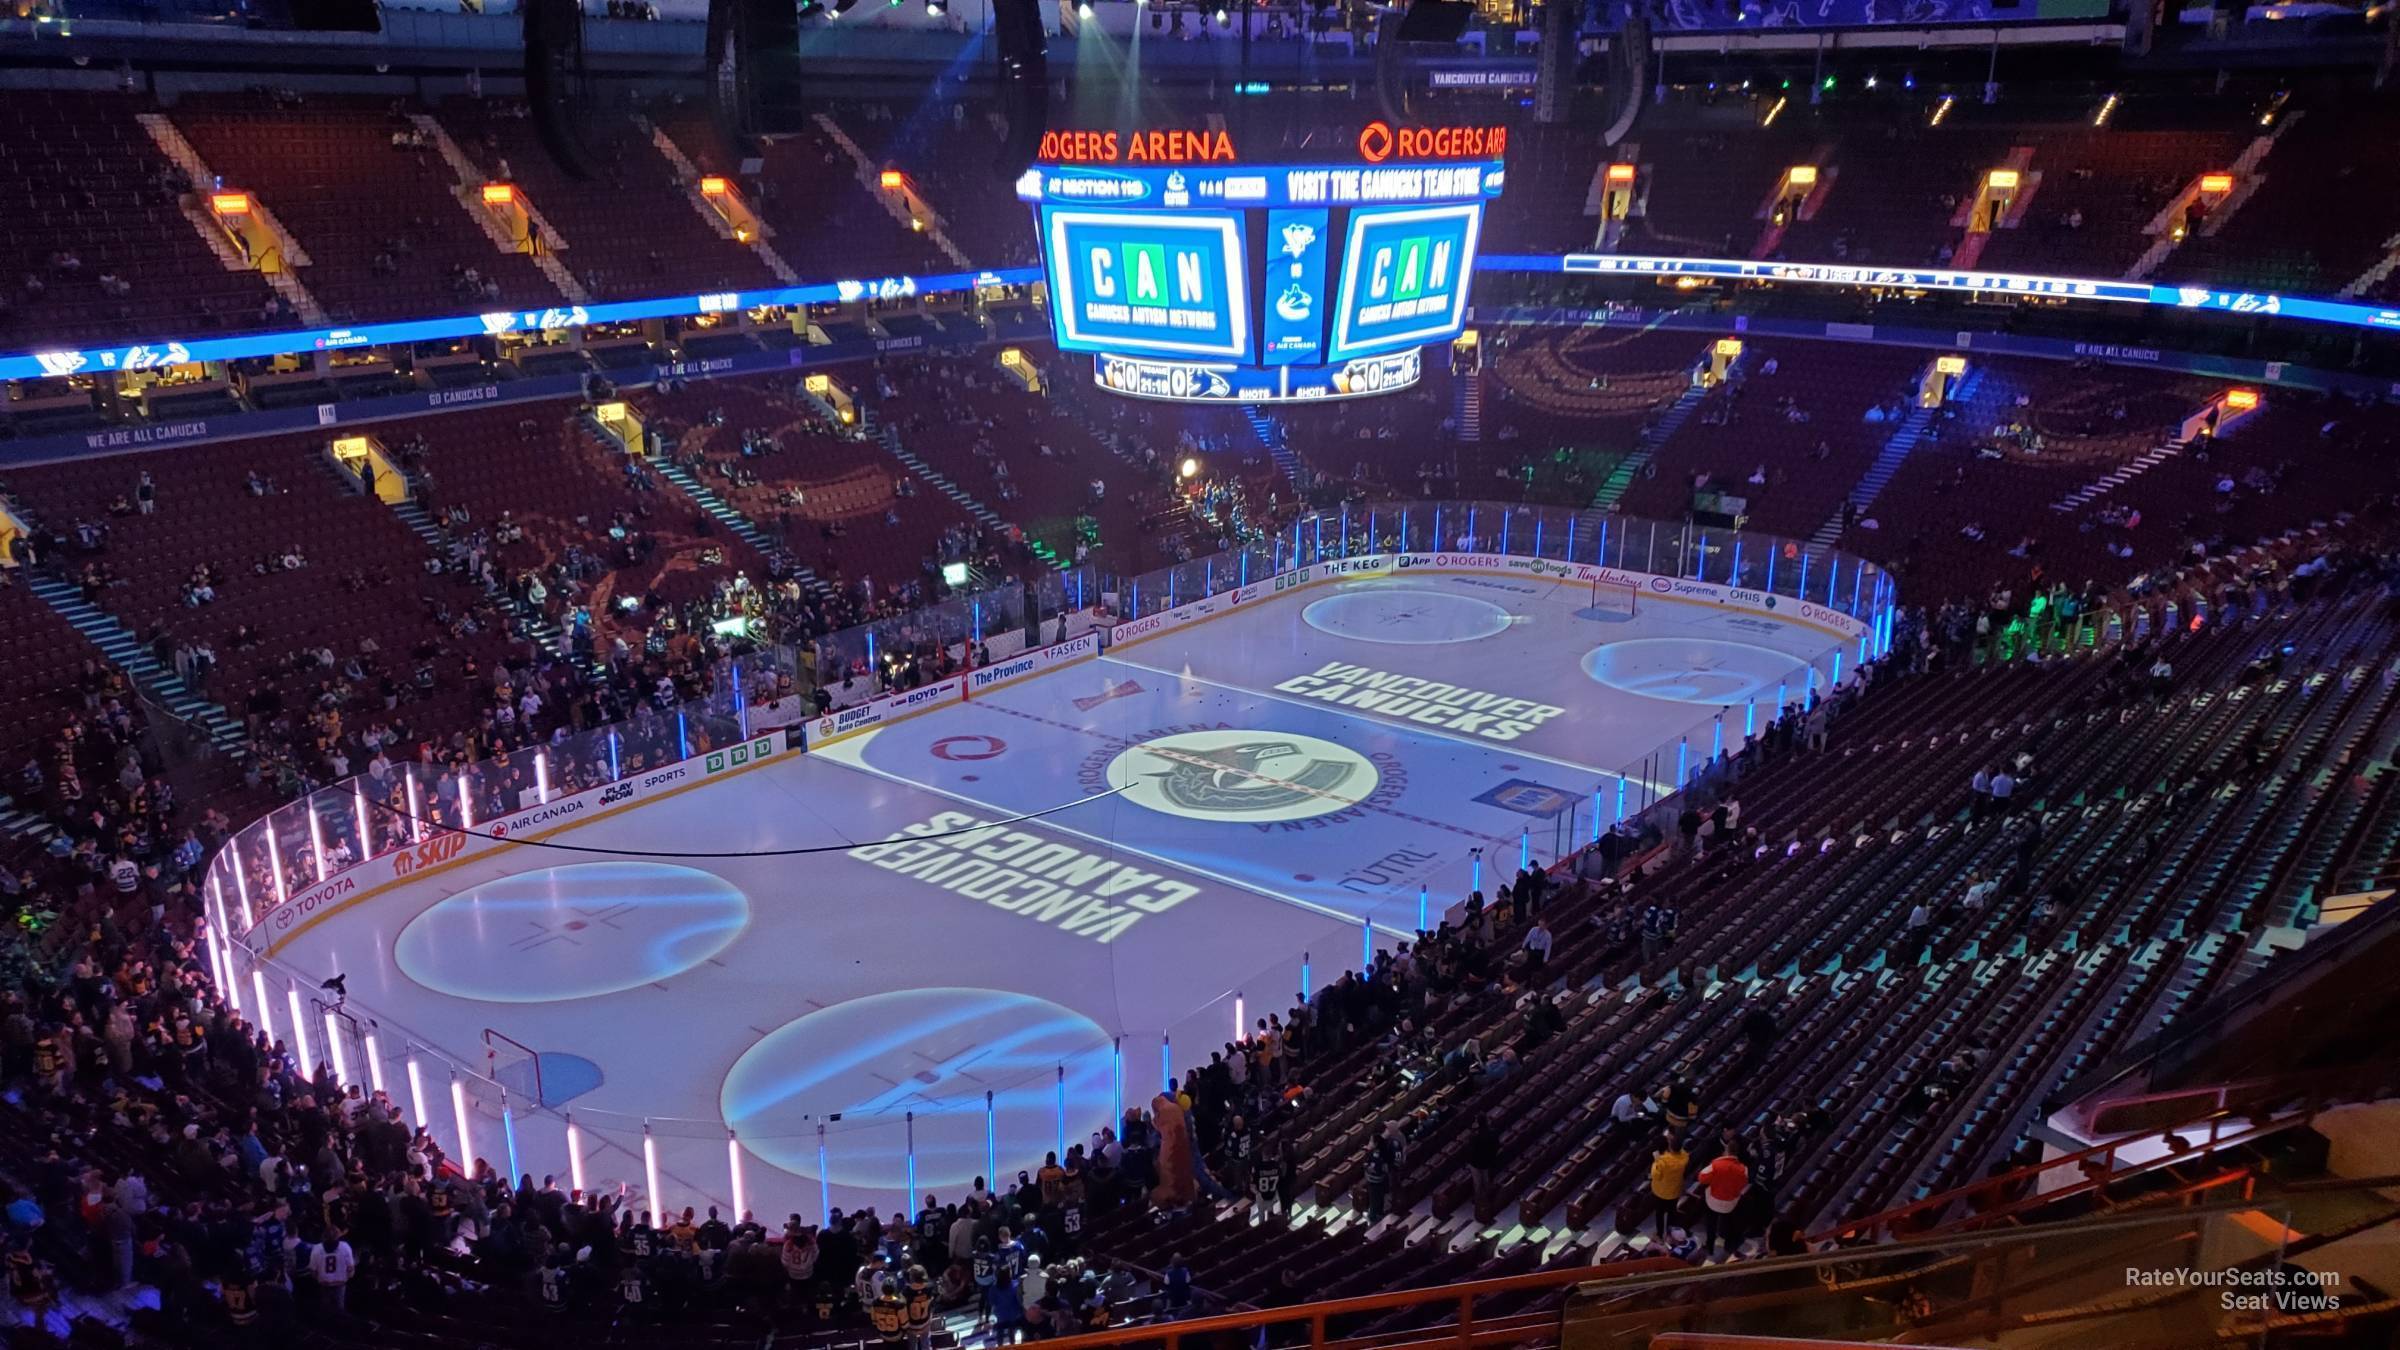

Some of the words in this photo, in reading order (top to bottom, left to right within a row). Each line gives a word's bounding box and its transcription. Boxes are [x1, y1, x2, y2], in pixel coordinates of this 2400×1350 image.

[1434, 72, 1487, 84] VANCOUVER
[1488, 72, 1534, 84] CANUCKS
[1039, 130, 1118, 160] ROGERS
[1128, 130, 1235, 160] ARENA
[1399, 127, 1483, 157] ROGERS
[1288, 171, 1329, 201] VISIT
[1331, 170, 1360, 200] THE
[1361, 168, 1422, 199] CANUCKS
[1423, 168, 1454, 197] TEAM
[1086, 303, 1130, 325] CANUCKS
[1132, 306, 1167, 327] AUTISM
[1169, 308, 1217, 332] NETWORK
[2122, 347, 2160, 361] CANUCKS
[658, 364, 670, 377] WE
[671, 363, 685, 375] ARE
[687, 361, 699, 374] ALL
[701, 358, 733, 373] CANUCKS
[429, 392, 442, 406] GO
[444, 388, 484, 404] CANUCKS
[485, 386, 498, 399] GO
[87, 434, 105, 449] WE
[108, 430, 129, 446] ARE
[133, 428, 153, 442] ALL
[156, 421, 207, 440] CANUCKS
[1323, 562, 1348, 576] THE
[1353, 558, 1380, 571] KEG
[1451, 556, 1500, 568] ROGERS
[1508, 559, 1531, 569] save
[1545, 561, 1572, 576] foods
[1576, 565, 1598, 582] Tim
[1598, 568, 1643, 589] Hortons
[1674, 582, 1718, 597] Supreme
[1729, 589, 1760, 603] ORIS
[1126, 617, 1161, 638] ROGERS
[1813, 608, 1851, 631] ROGERS
[1050, 637, 1091, 659] FASKEN
[975, 671, 993, 686] The
[993, 659, 1034, 684] Province
[907, 687, 938, 703] BOYD
[1312, 661, 1566, 724] VANCOUVER
[838, 706, 871, 725] BUDGET
[1273, 675, 1536, 741] CANUCKS
[837, 721, 853, 733] Auto
[854, 713, 882, 730] Centres
[605, 781, 633, 795] PLAY
[644, 768, 686, 788] SPORTS
[606, 788, 634, 804] NOW
[511, 817, 531, 832] AIR
[533, 800, 584, 824] CANADA
[415, 830, 467, 870] SKIP
[904, 811, 1202, 913] CANUCKS
[118, 867, 134, 879] 22
[296, 877, 355, 916] TOYOTA
[847, 833, 1144, 944] VANCOUVER
[1258, 1176, 1280, 1193] 87
[1064, 1214, 1081, 1233] 53
[325, 1251, 337, 1273] 8
